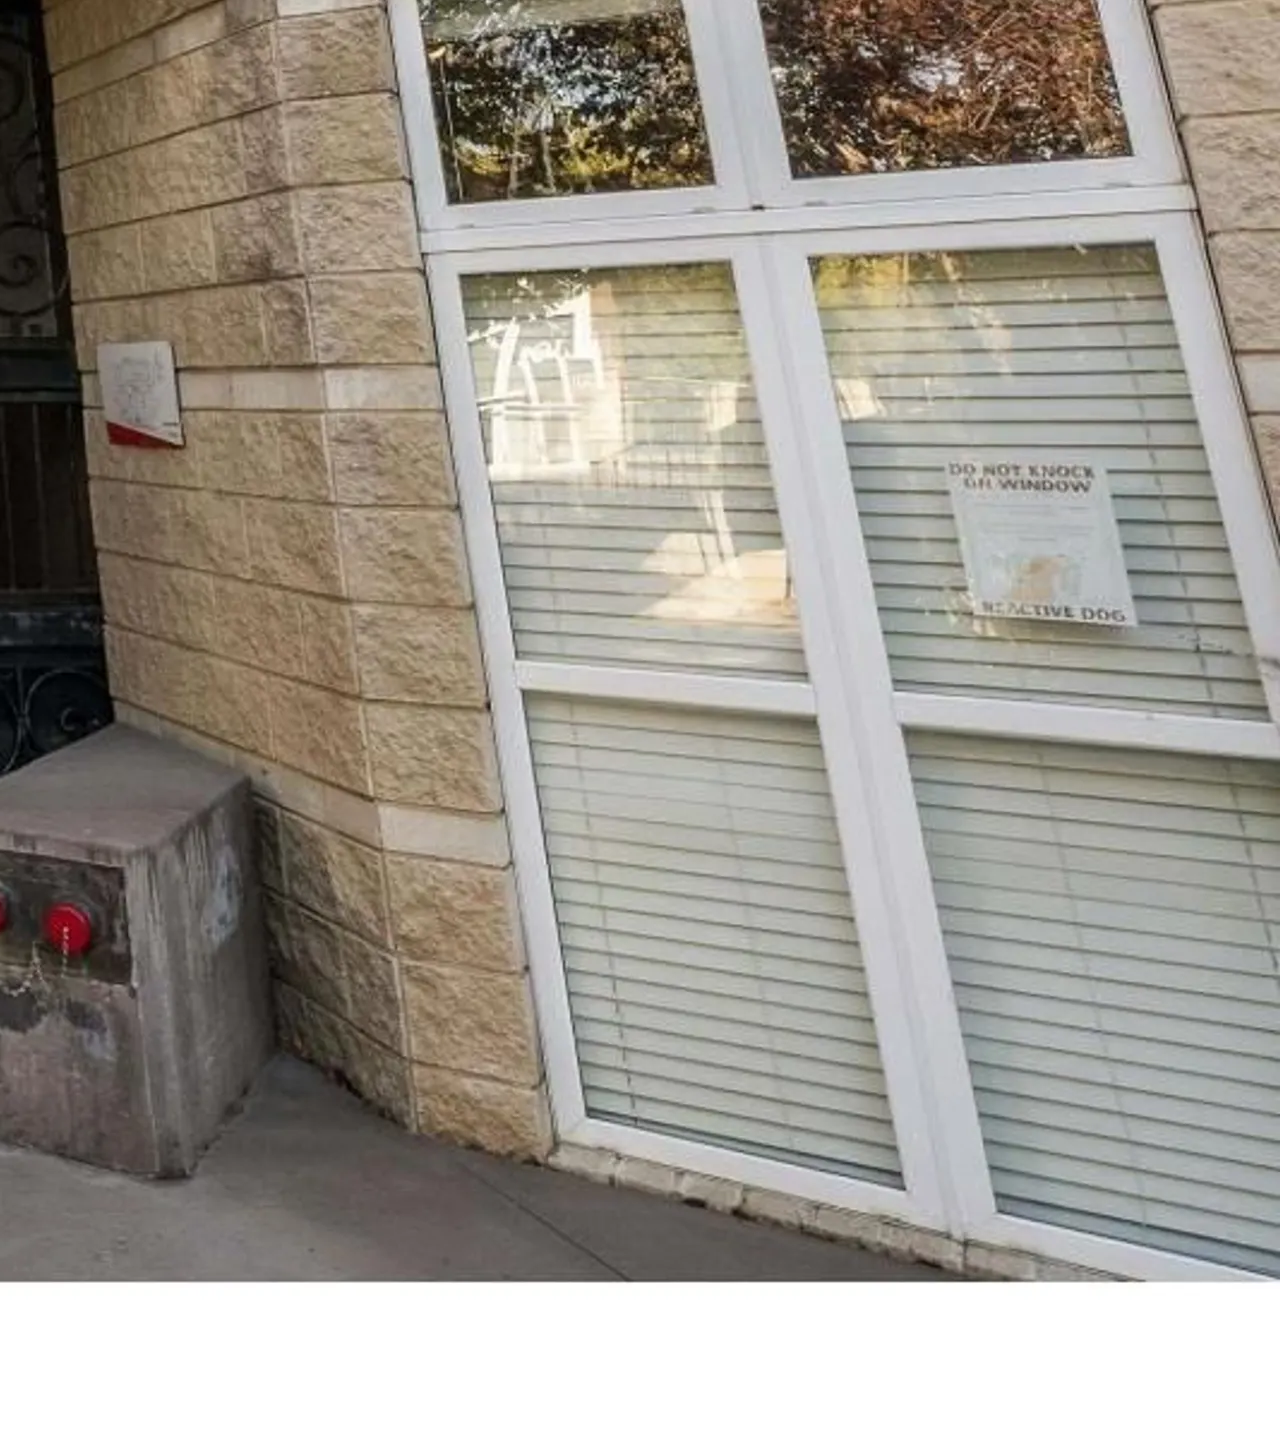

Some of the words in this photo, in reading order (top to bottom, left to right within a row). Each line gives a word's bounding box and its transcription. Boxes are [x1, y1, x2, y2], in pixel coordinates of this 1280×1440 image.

[948, 462, 977, 477] DO
[983, 464, 1021, 477] NOT
[1028, 464, 1096, 480] KNOCK
[999, 478, 1092, 493] WINDOW
[1081, 606, 1127, 623] DOG
